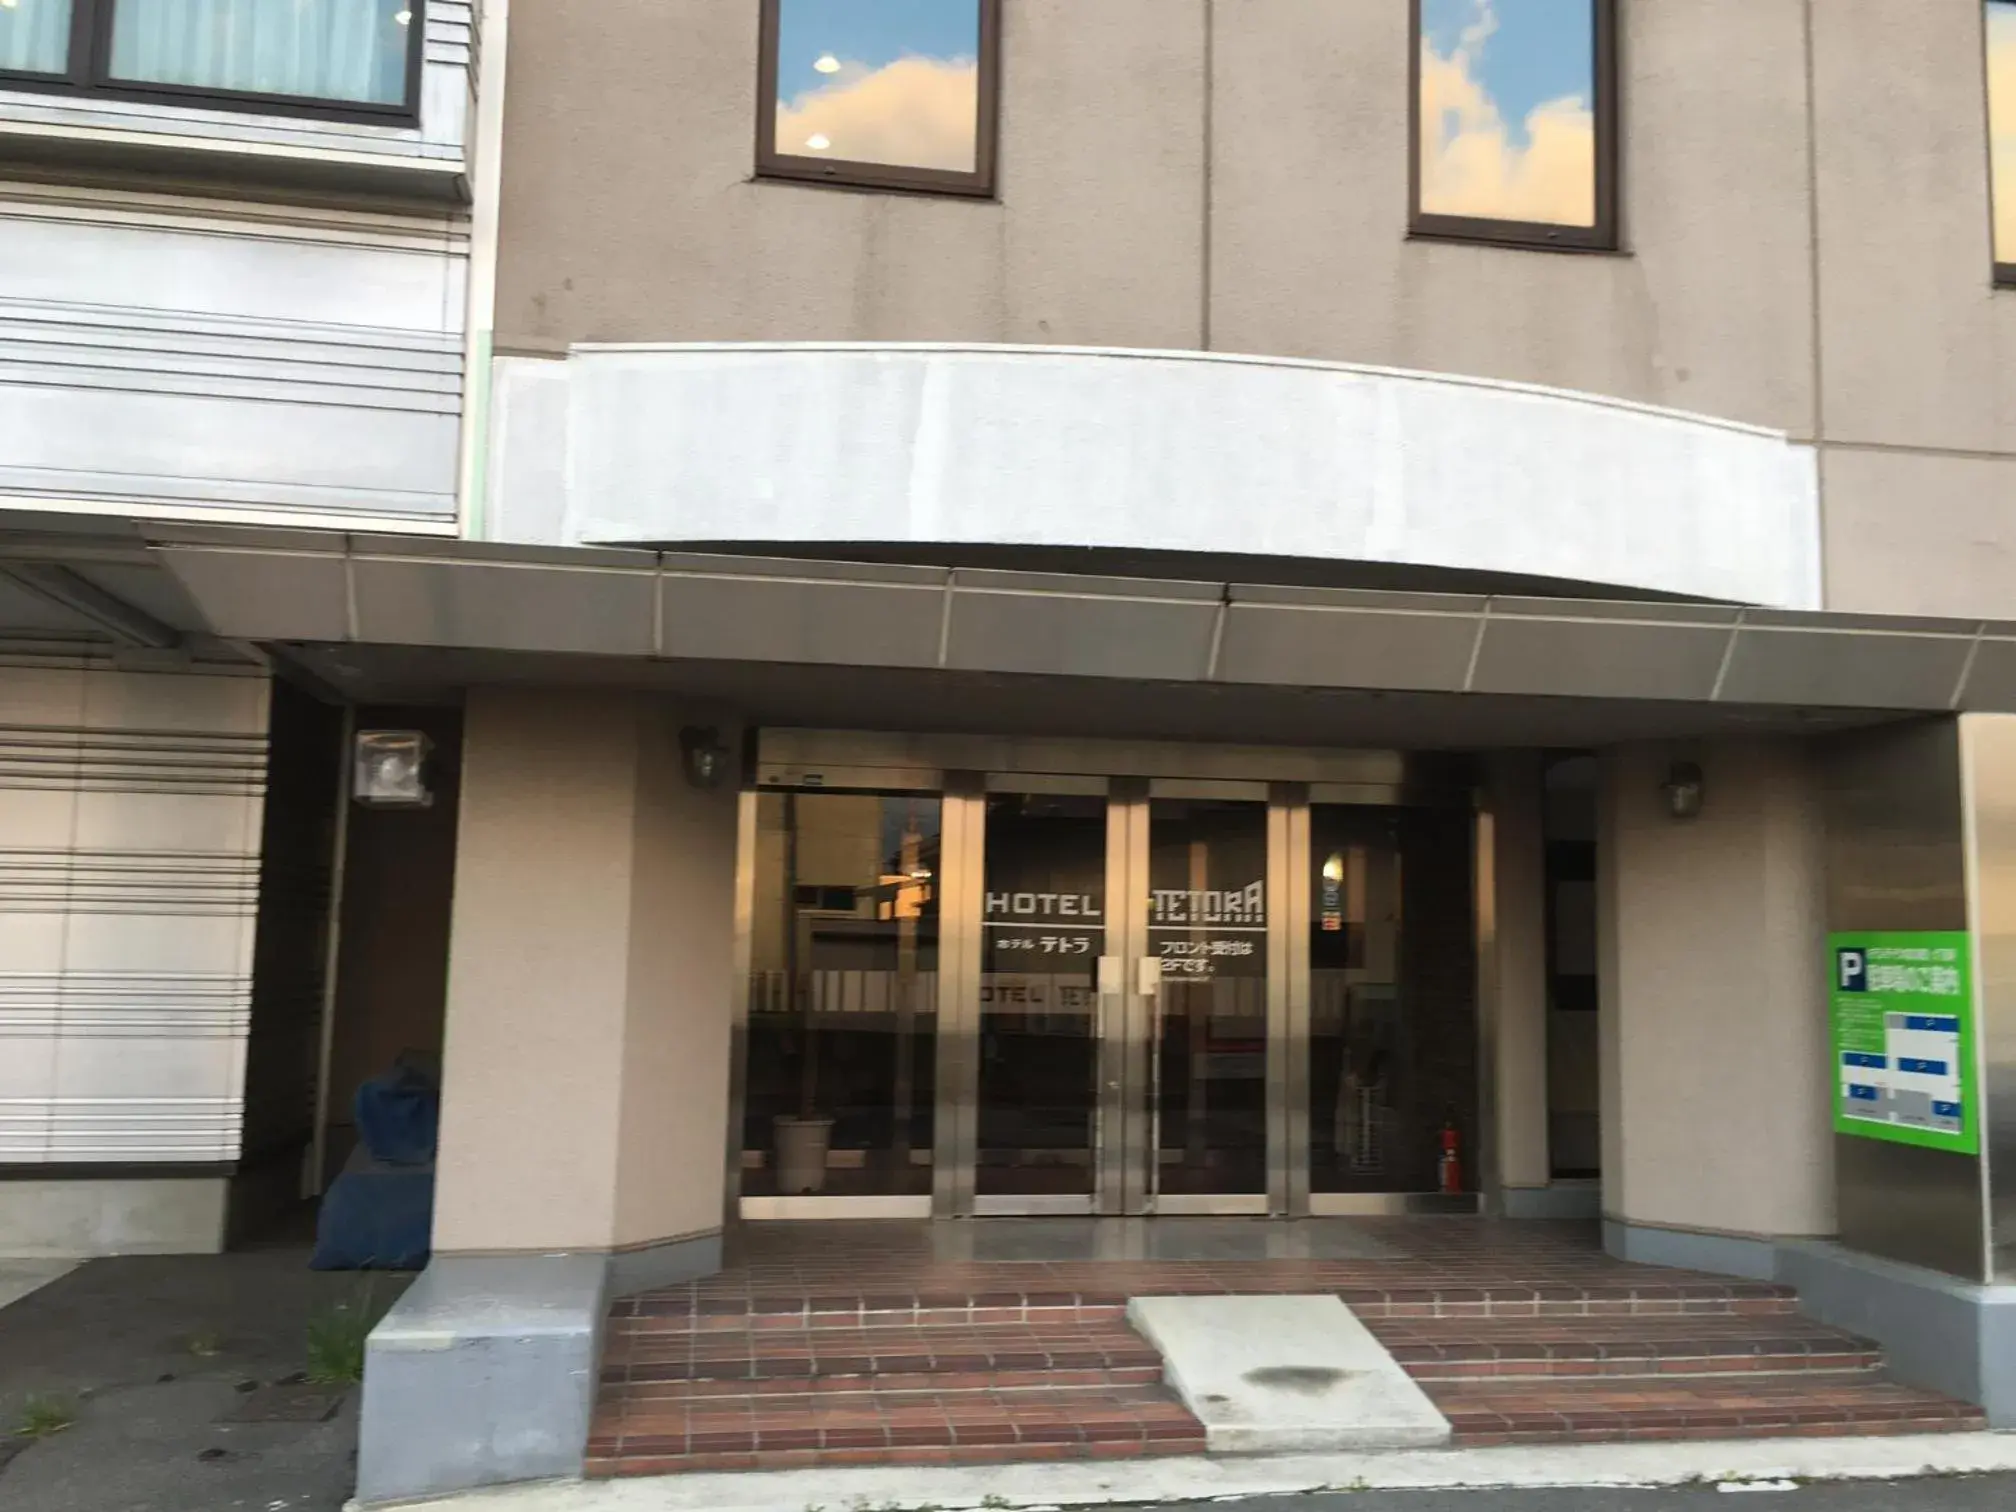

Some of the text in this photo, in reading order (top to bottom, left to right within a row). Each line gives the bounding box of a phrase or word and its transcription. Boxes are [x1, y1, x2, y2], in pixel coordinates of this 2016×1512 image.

[986, 880, 1264, 923] HOTEL TETORA
[997, 936, 1091, 954] ホテル テトラ
[1840, 952, 1863, 987] P
